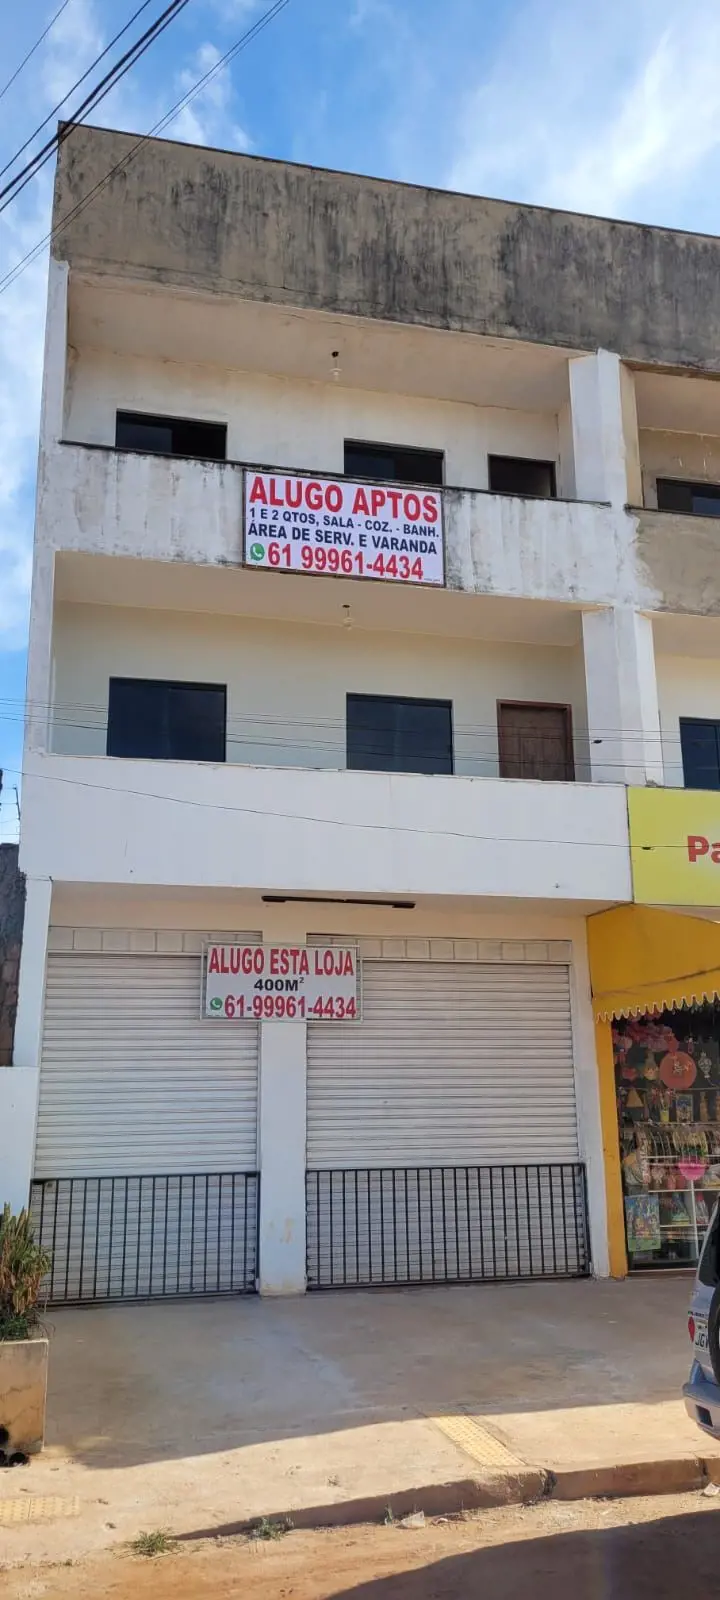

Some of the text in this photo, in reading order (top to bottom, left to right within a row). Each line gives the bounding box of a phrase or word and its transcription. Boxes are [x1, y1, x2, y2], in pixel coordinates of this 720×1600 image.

[249, 476, 438, 523] ALUGO APTOS
[248, 520, 437, 554] ÁREA DE SERV. E VARANDA
[249, 507, 256, 518] 1
[260, 508, 268, 519] E
[272, 510, 279, 520] 2
[283, 511, 319, 527] QTOS,
[323, 515, 354, 528] SALA
[365, 519, 393, 532] COZ.
[403, 523, 439, 537] BANH.
[268, 542, 424, 580] 61 99961-4434
[209, 947, 354, 976] ALUGO ESTA LOJA
[224, 994, 356, 1019] 61-99961-4434
